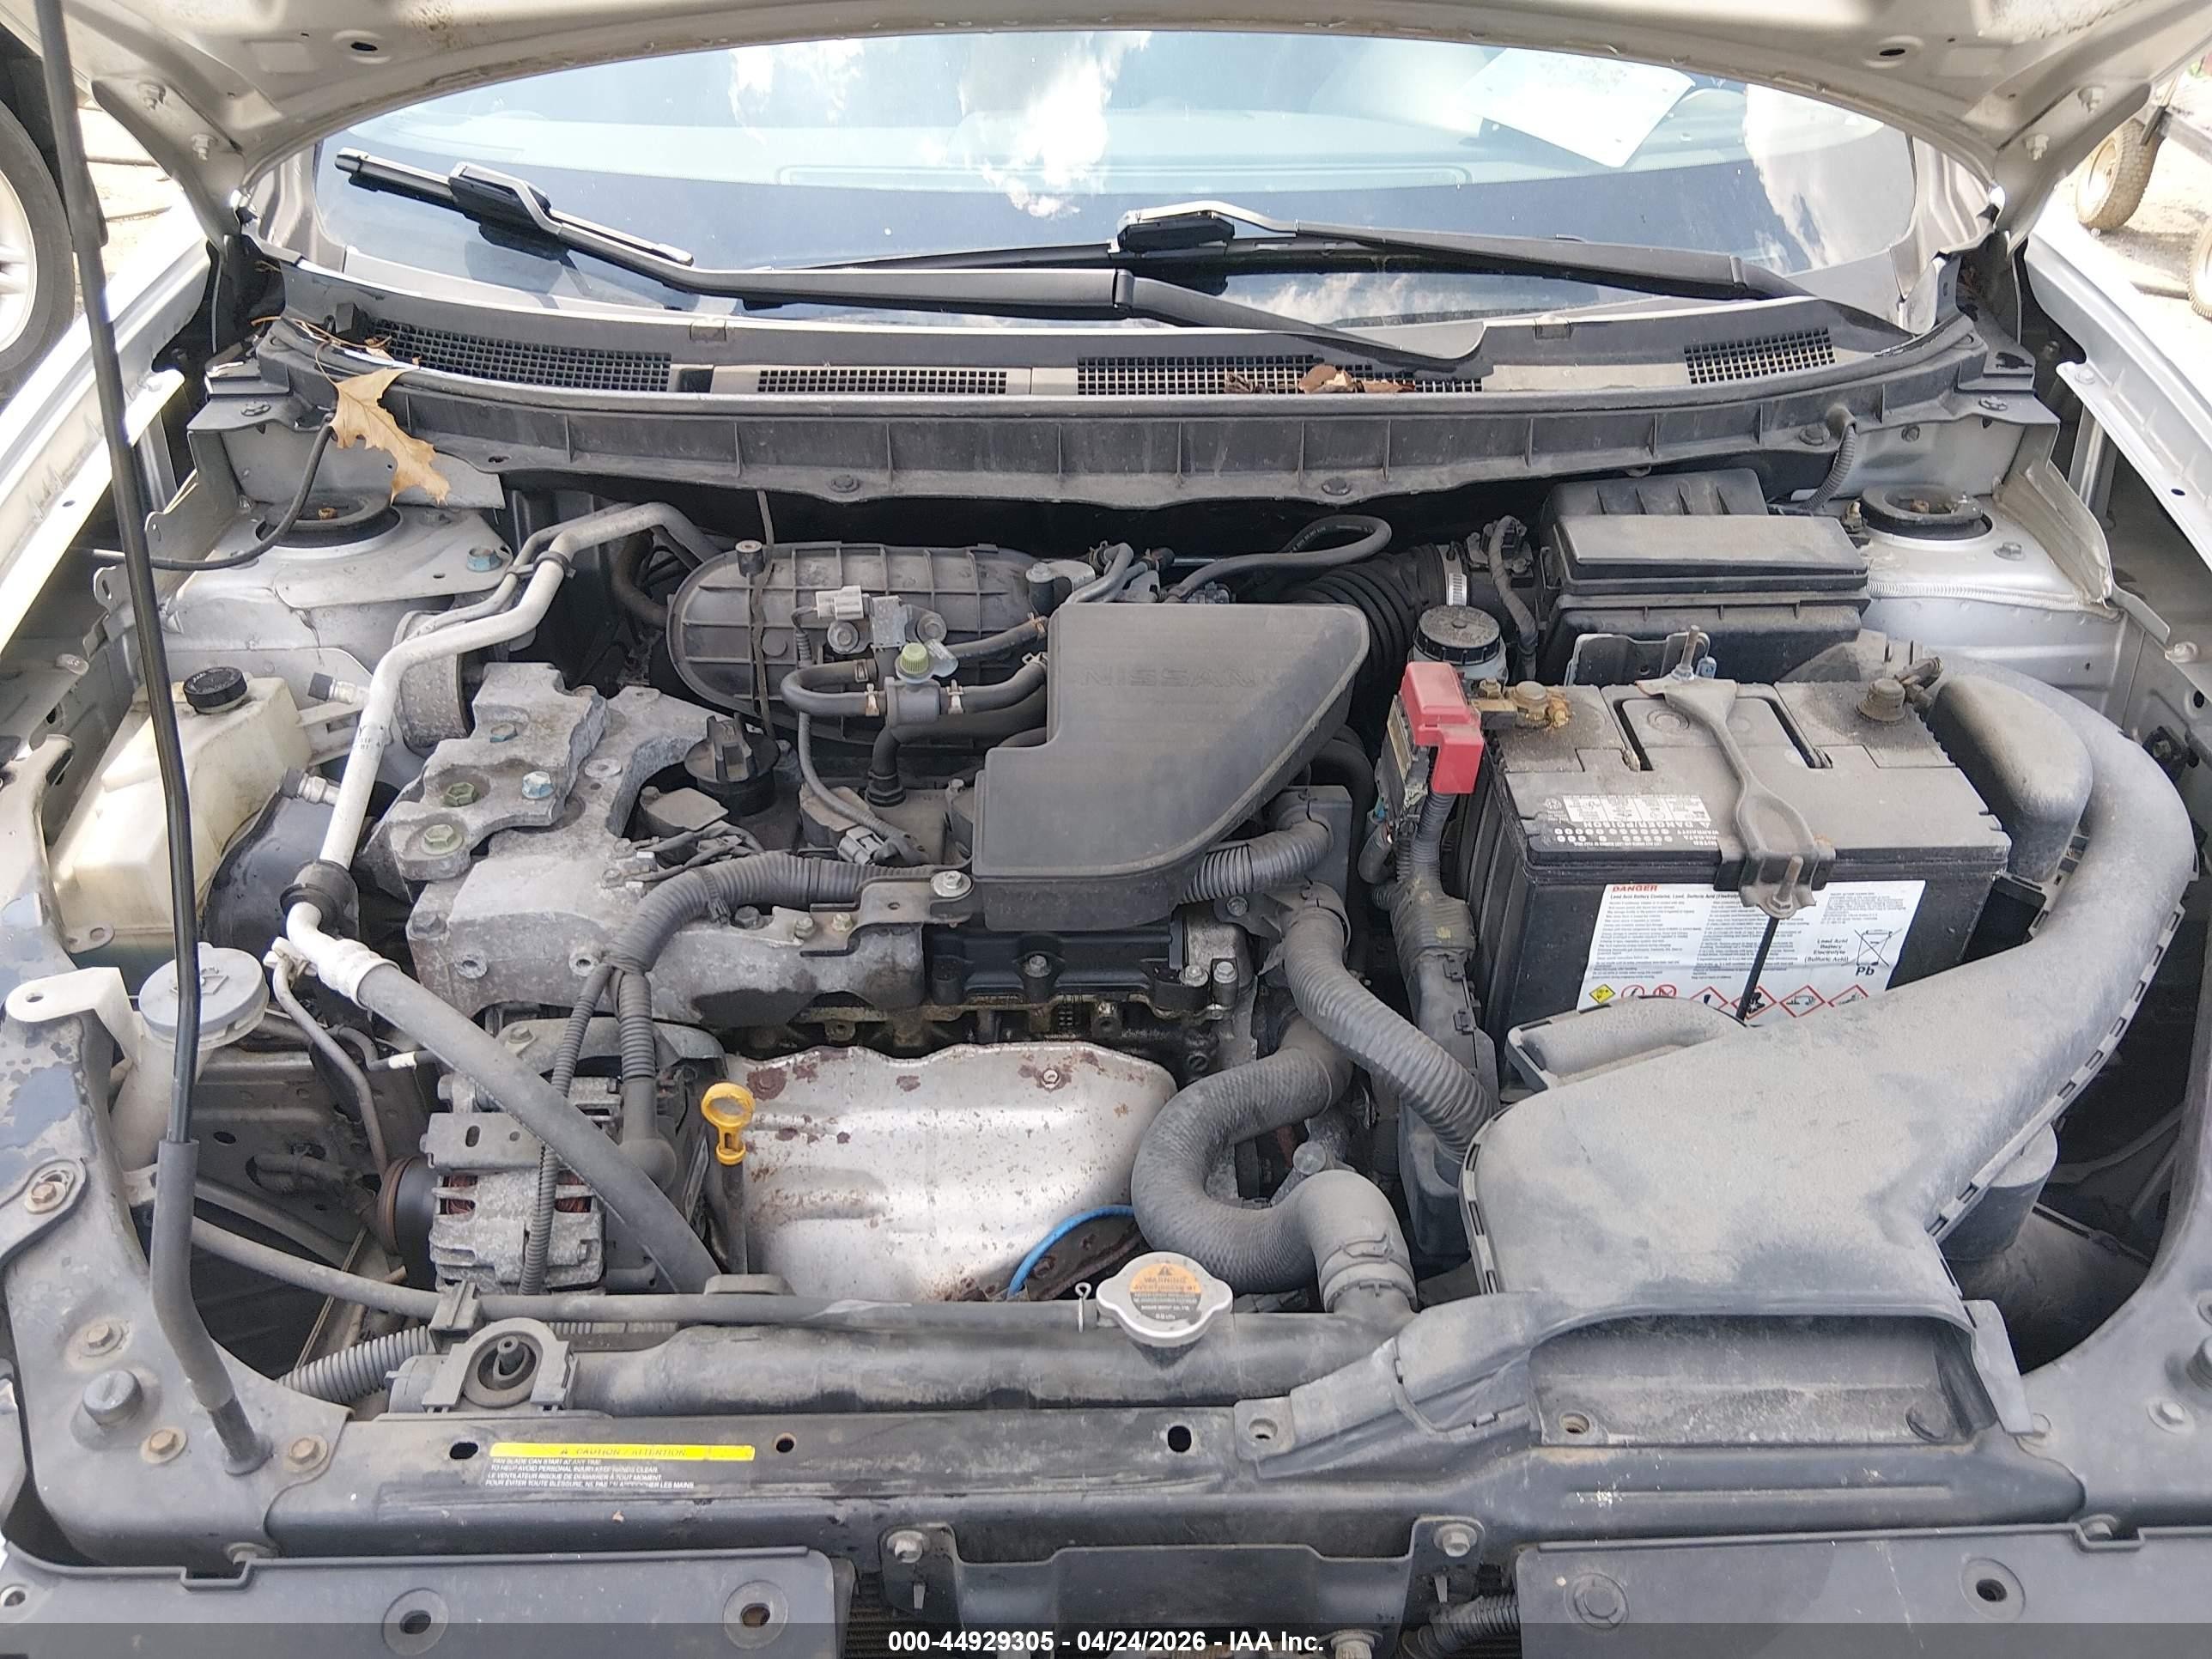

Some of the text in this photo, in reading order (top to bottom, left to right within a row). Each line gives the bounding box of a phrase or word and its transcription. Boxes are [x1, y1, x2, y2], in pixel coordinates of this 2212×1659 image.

[1085, 666, 1256, 687] NISSAN
[1613, 884, 1658, 893] DANGER
[1855, 965, 1875, 976] Pb
[632, 1449, 687, 1457] ATTENTION
